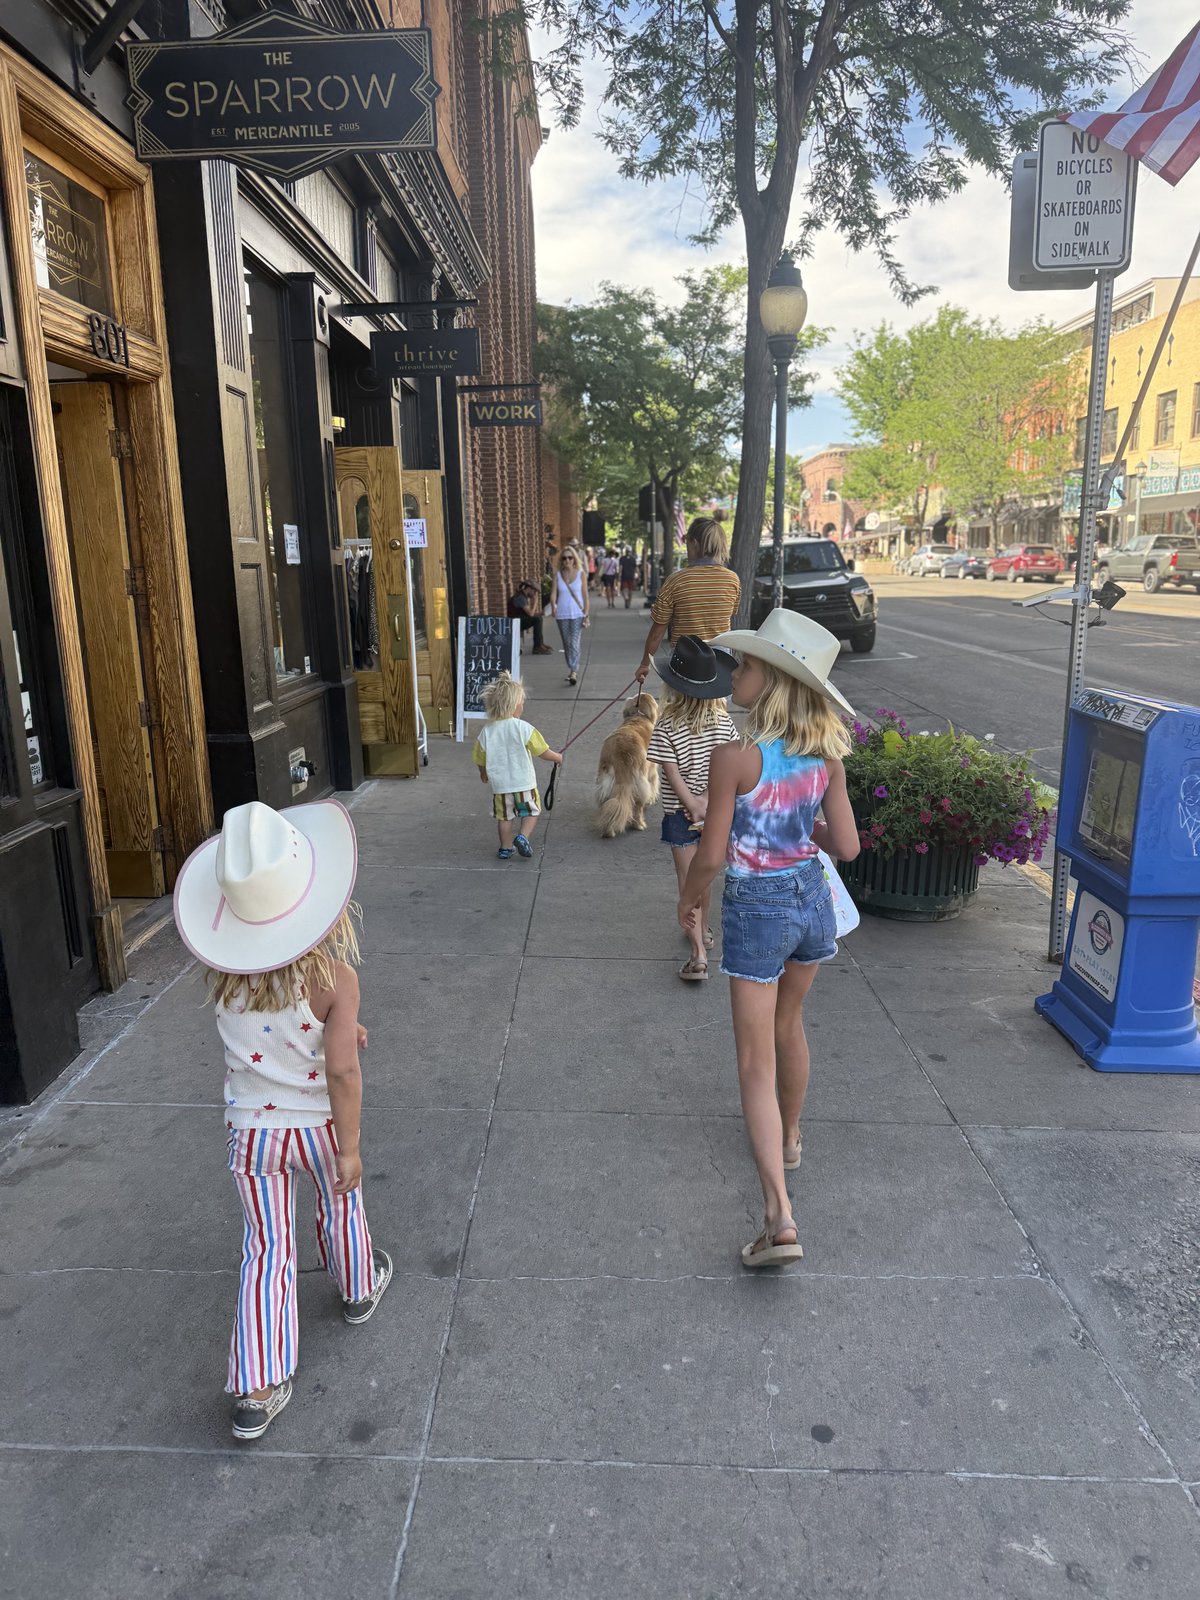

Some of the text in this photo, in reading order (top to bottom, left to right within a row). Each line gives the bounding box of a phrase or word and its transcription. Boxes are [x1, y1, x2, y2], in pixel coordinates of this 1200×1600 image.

[263, 51, 293, 66] THE
[165, 72, 397, 118] SPARROW
[235, 123, 334, 141] MERCANTILE
[339, 122, 360, 132] 2005
[1071, 131, 1100, 154] NO
[1056, 158, 1113, 176] BICYCLES
[1076, 179, 1091, 196] OR
[1043, 198, 1122, 218] SKATEBOARDS
[1074, 221, 1090, 237] ON
[1051, 240, 1110, 258] SIDEWALK
[87, 313, 130, 368] 801
[394, 343, 459, 363] thrive
[474, 404, 537, 421] WORK
[467, 616, 512, 635] FOURTH
[470, 645, 502, 660] JULY
[468, 658, 502, 672] SALE
